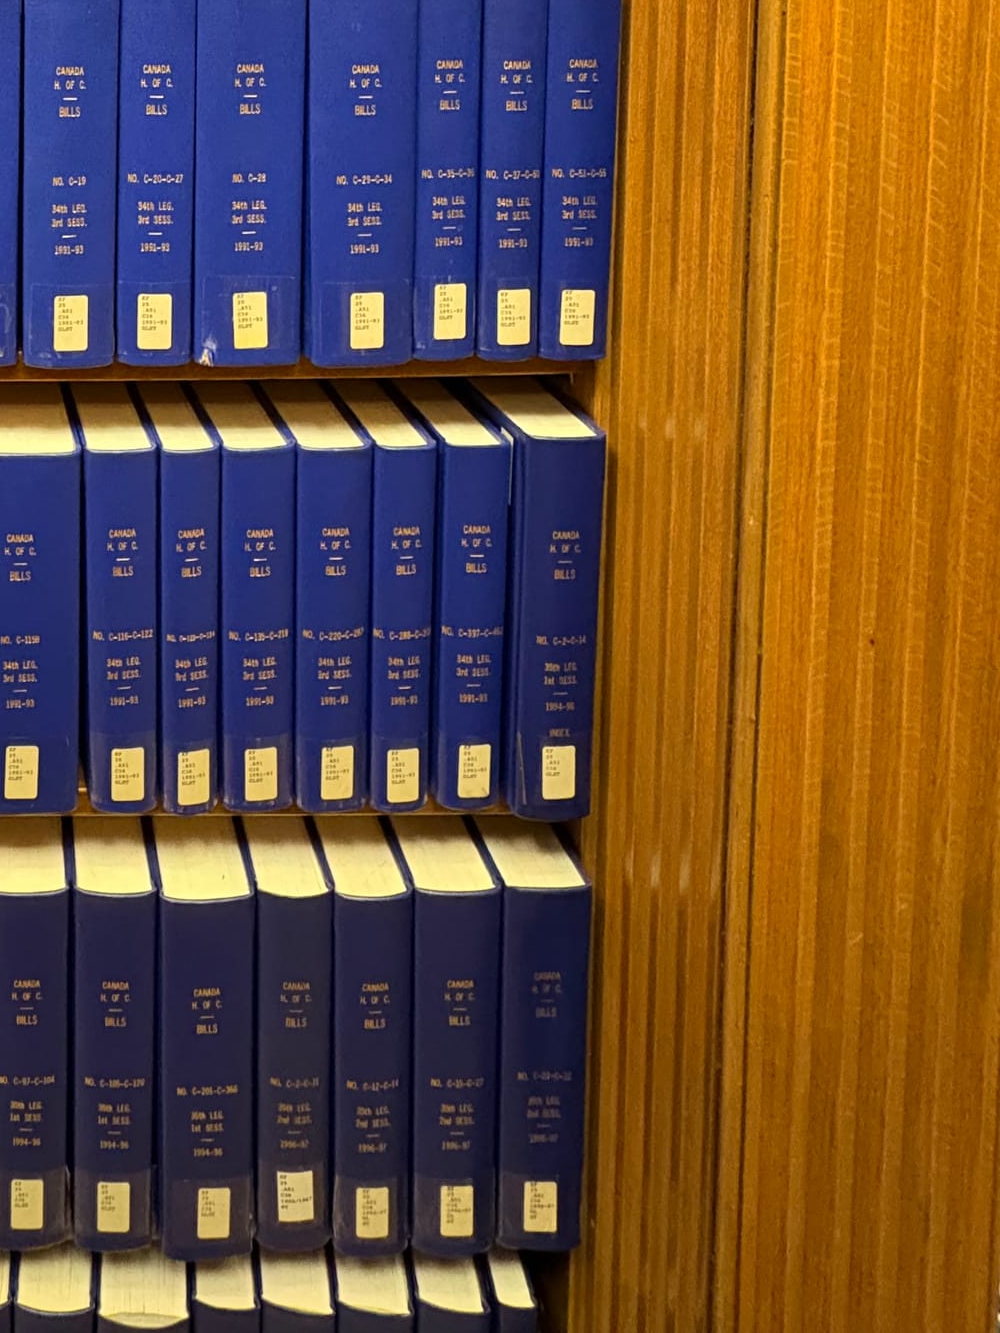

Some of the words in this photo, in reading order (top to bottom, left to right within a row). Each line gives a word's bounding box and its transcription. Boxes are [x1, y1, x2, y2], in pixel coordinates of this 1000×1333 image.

[237, 64, 264, 73] CANADA
[246, 78, 255, 87] OF
[240, 104, 260, 114] BILLS
